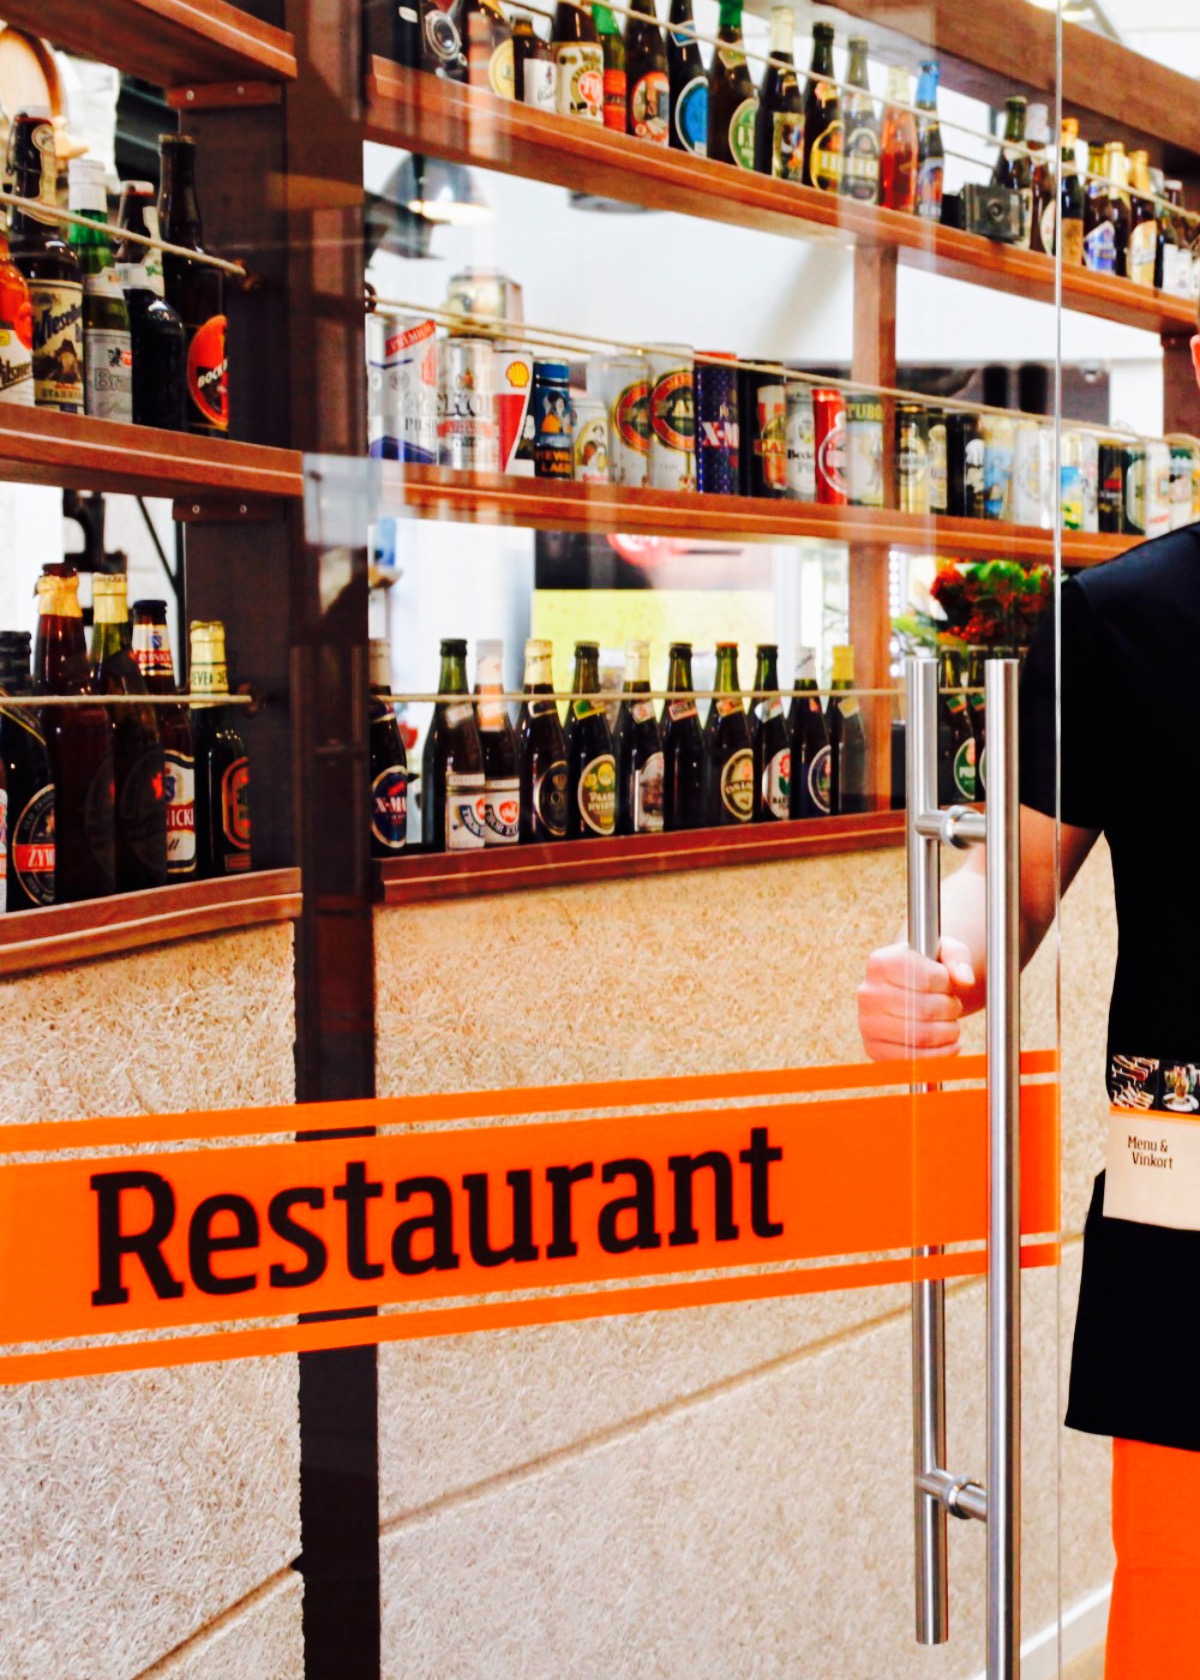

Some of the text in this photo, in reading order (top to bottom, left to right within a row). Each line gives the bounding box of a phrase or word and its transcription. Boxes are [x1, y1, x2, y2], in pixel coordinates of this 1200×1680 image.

[1127, 1135, 1169, 1152] Menu &
[1131, 1151, 1174, 1169] Vinkort
[89, 1126, 784, 1307] Restaurant
